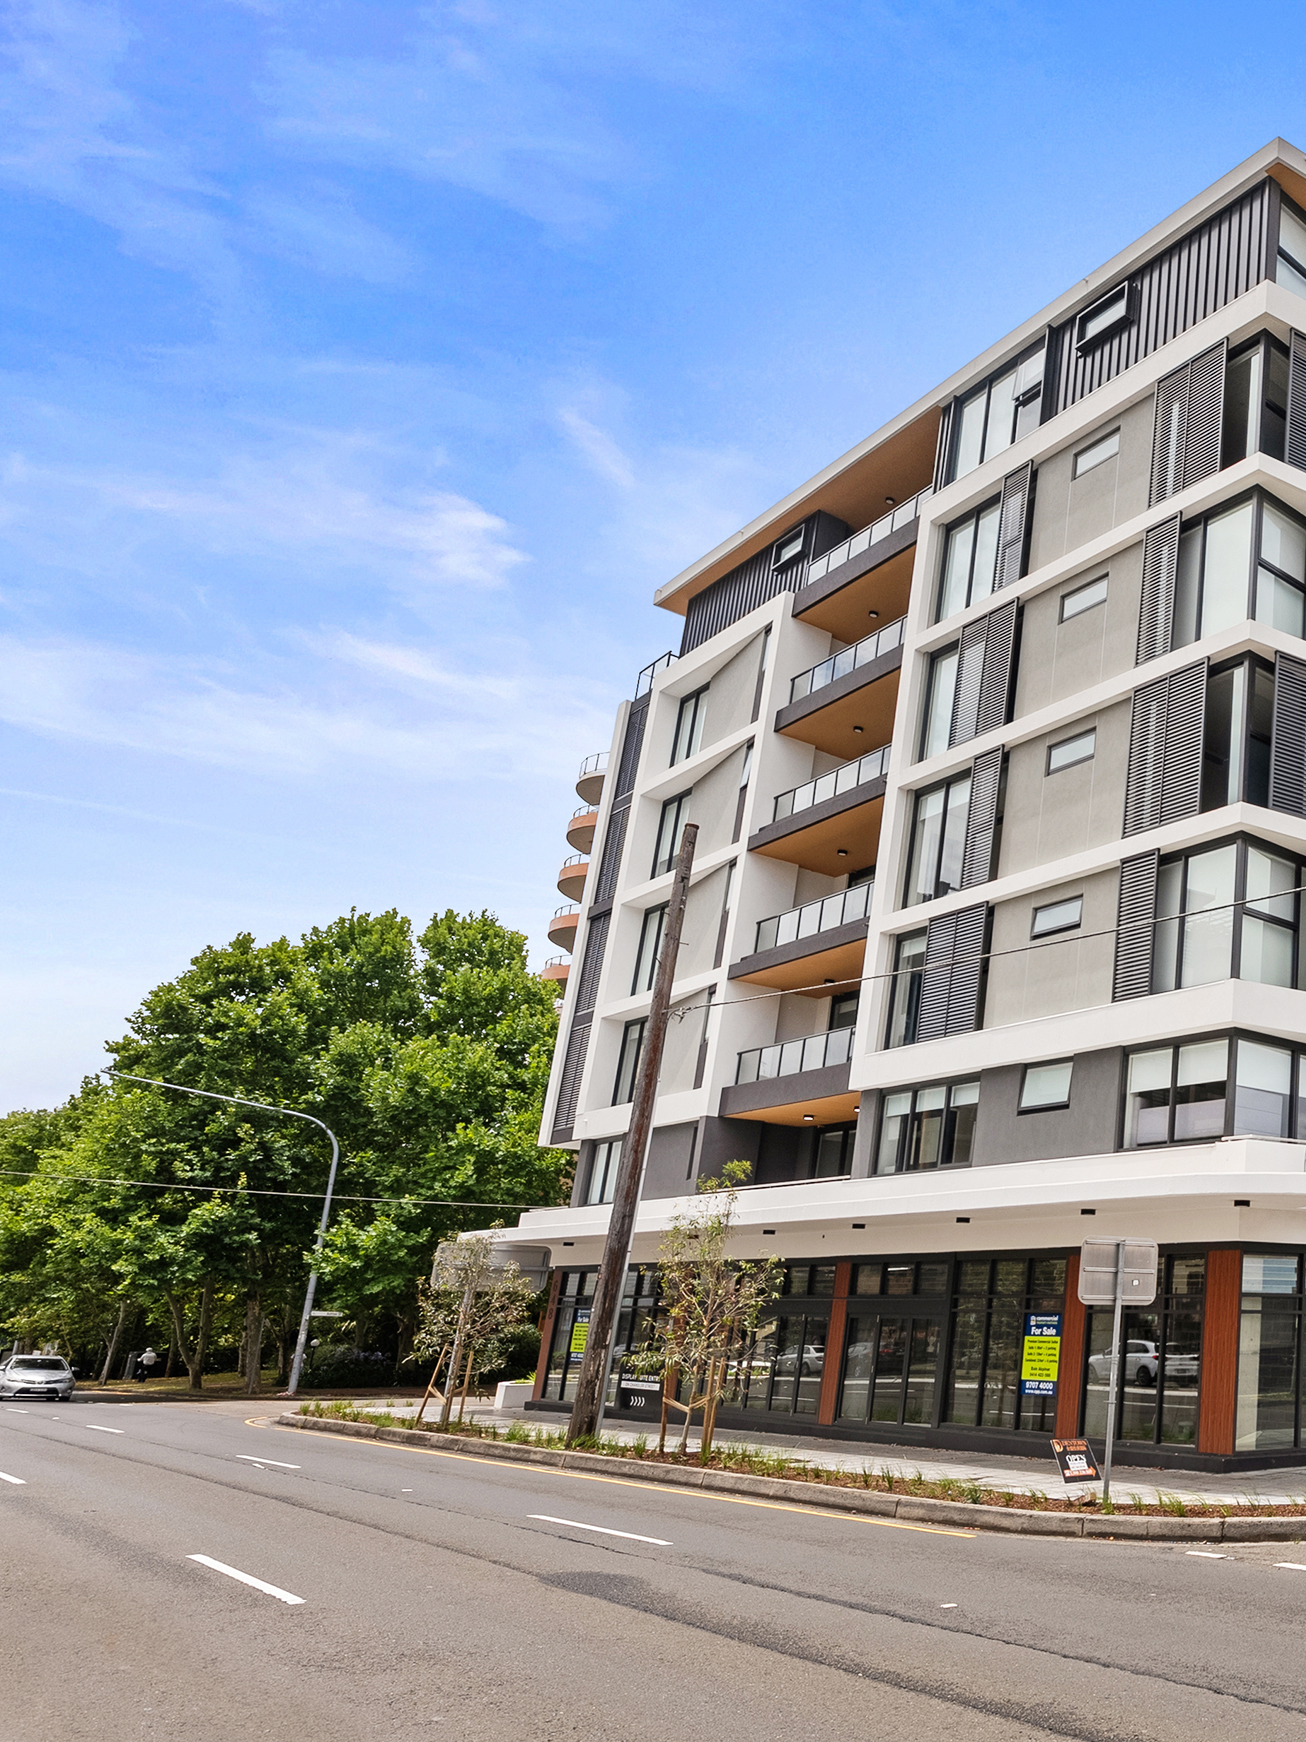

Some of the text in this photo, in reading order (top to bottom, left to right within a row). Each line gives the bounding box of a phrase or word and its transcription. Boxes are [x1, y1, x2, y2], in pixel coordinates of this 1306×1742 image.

[1031, 1326, 1057, 1336] For Sale
[1025, 1381, 1053, 1390] 9707 4000
[1066, 1454, 1087, 1462] OPEN
